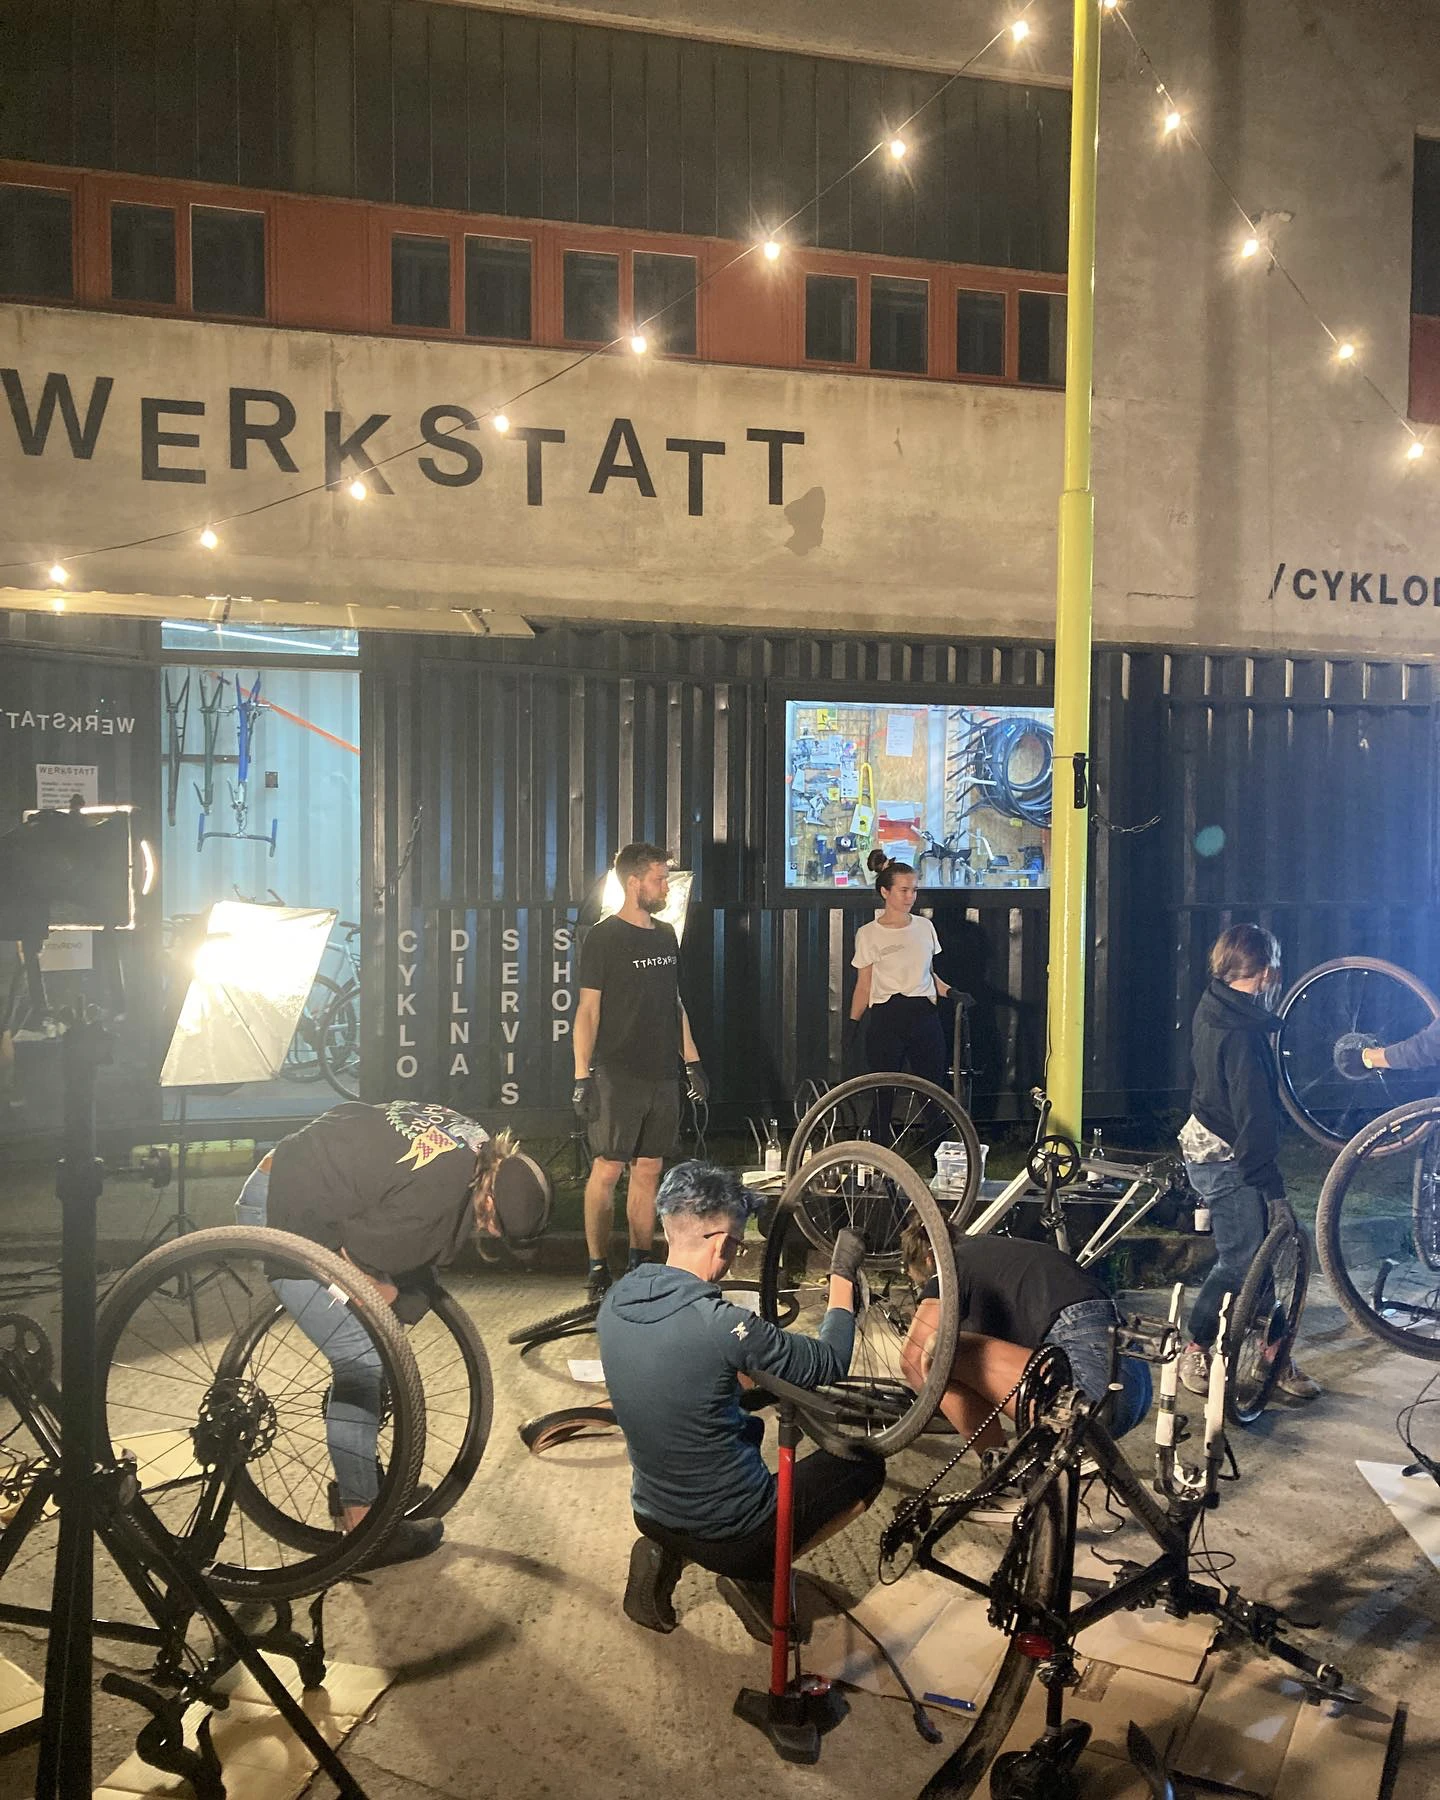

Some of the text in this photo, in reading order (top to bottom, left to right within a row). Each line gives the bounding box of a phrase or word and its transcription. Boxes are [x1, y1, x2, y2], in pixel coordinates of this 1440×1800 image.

[1, 368, 805, 517] WERKSTATT
[1268, 563, 1440, 607] /CYKLO
[39, 766, 95, 776] WERKSTATT
[396, 929, 418, 1078] CYKLO
[450, 929, 470, 1076] DÍLNA
[501, 928, 520, 1105] SERVIS
[551, 928, 572, 1042] SHOP
